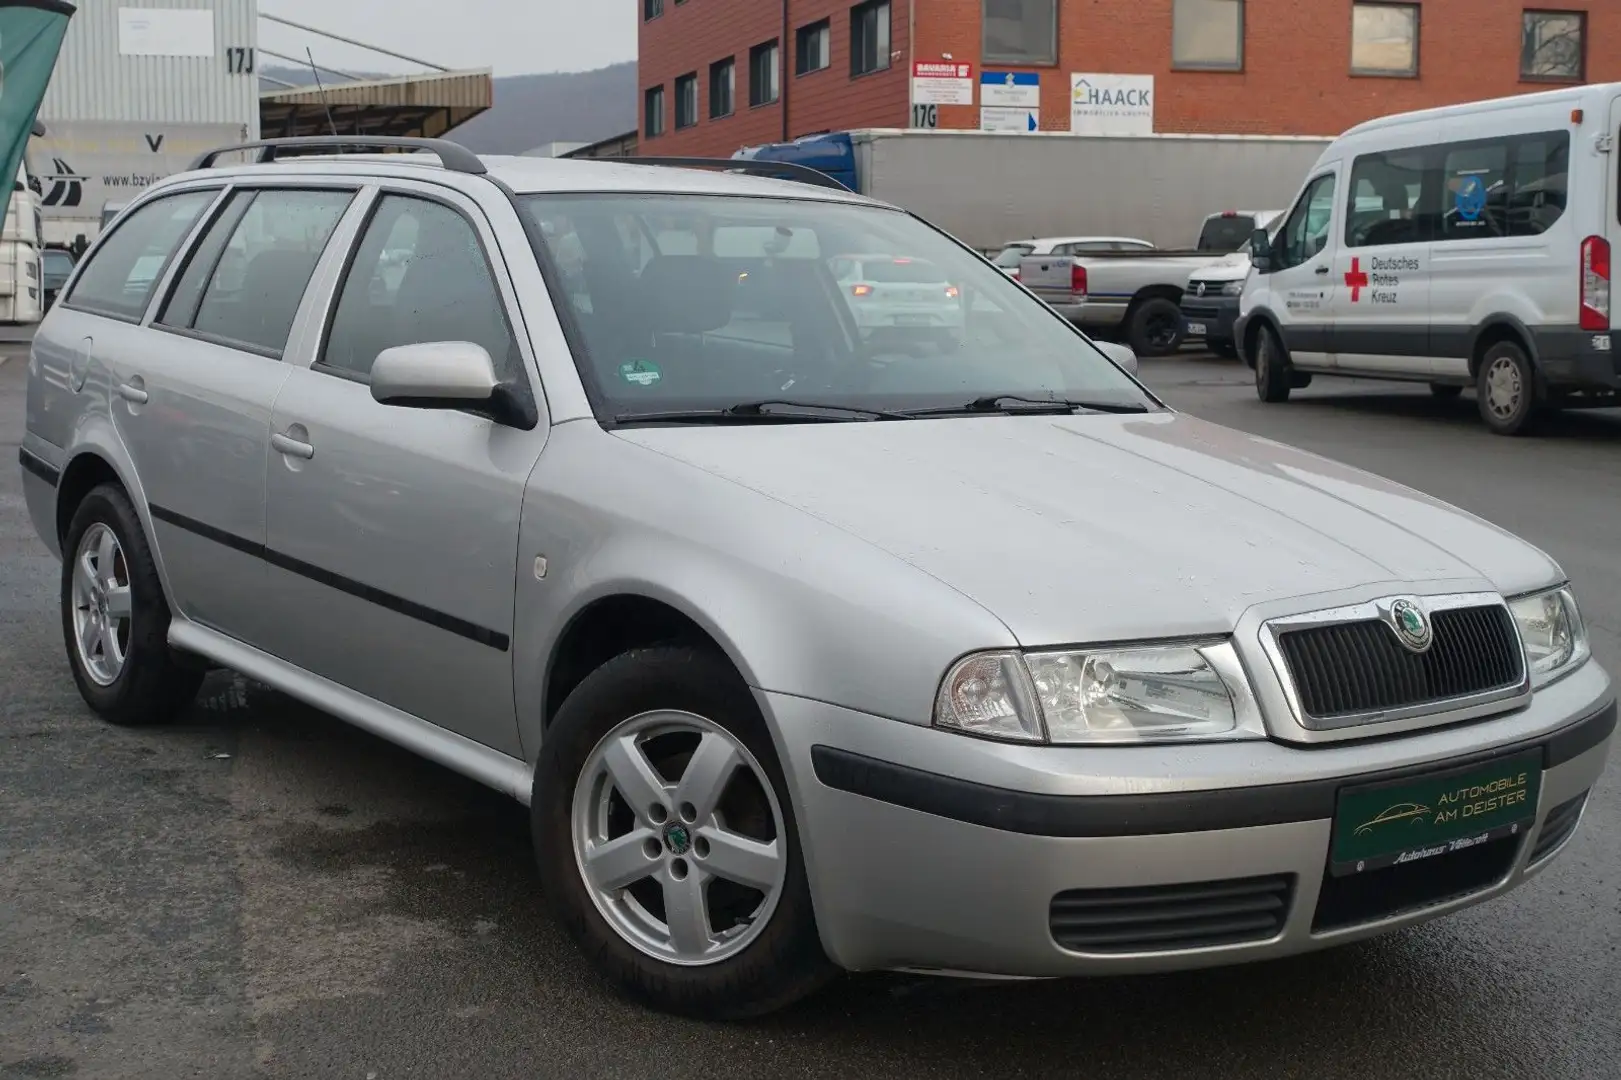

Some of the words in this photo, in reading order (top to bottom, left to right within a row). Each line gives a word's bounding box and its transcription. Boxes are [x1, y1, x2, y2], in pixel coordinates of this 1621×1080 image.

[226, 47, 254, 74] 17J
[1088, 88, 1150, 106] HAACK
[913, 104, 936, 127] 17G
[145, 134, 164, 153] V
[1371, 256, 1420, 271] Deutsches
[1372, 273, 1399, 287] Rotes
[1371, 289, 1398, 304] Kreuz
[1438, 772, 1527, 806] AUTOMOBILE
[1434, 808, 1458, 825] AM
[1462, 789, 1526, 818] DEISTER
